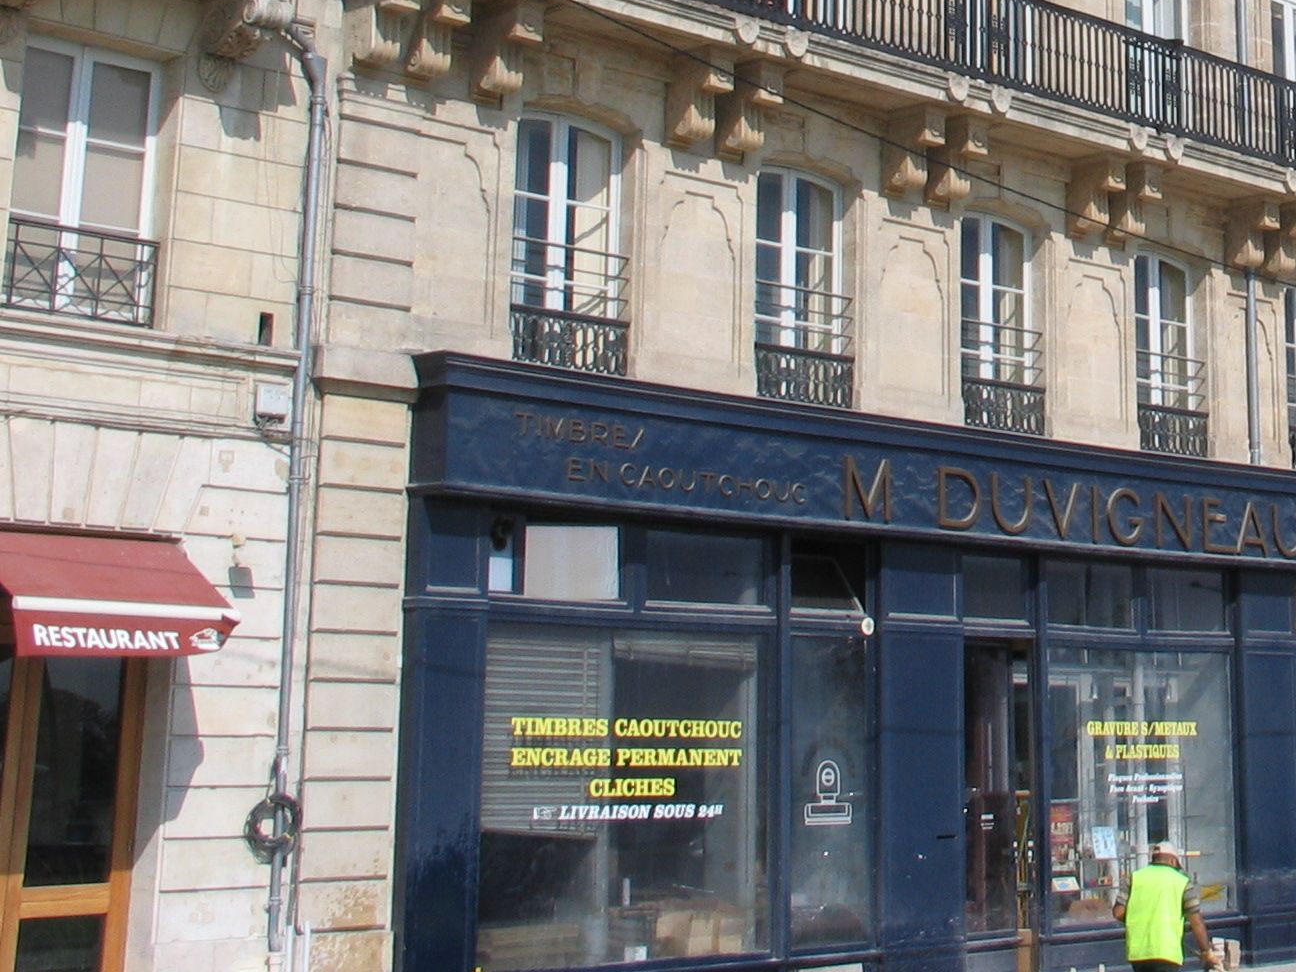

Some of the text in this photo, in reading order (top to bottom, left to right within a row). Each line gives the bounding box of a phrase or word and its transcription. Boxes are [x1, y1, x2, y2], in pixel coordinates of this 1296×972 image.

[566, 456, 808, 505] EN CAOUTCHOUC
[842, 454, 893, 525] M
[32, 623, 181, 651] RESTAURANT
[511, 716, 743, 739] TIMBRES CAOUTCHOUC
[1086, 720, 1140, 736] GRAVURE
[510, 746, 743, 767] ENCRAGE PERMANENT
[1115, 744, 1180, 759] PLASTIQUES
[589, 777, 676, 798] CLICHES
[557, 804, 652, 821] LIVRAISON
[652, 803, 696, 819] SOUS
